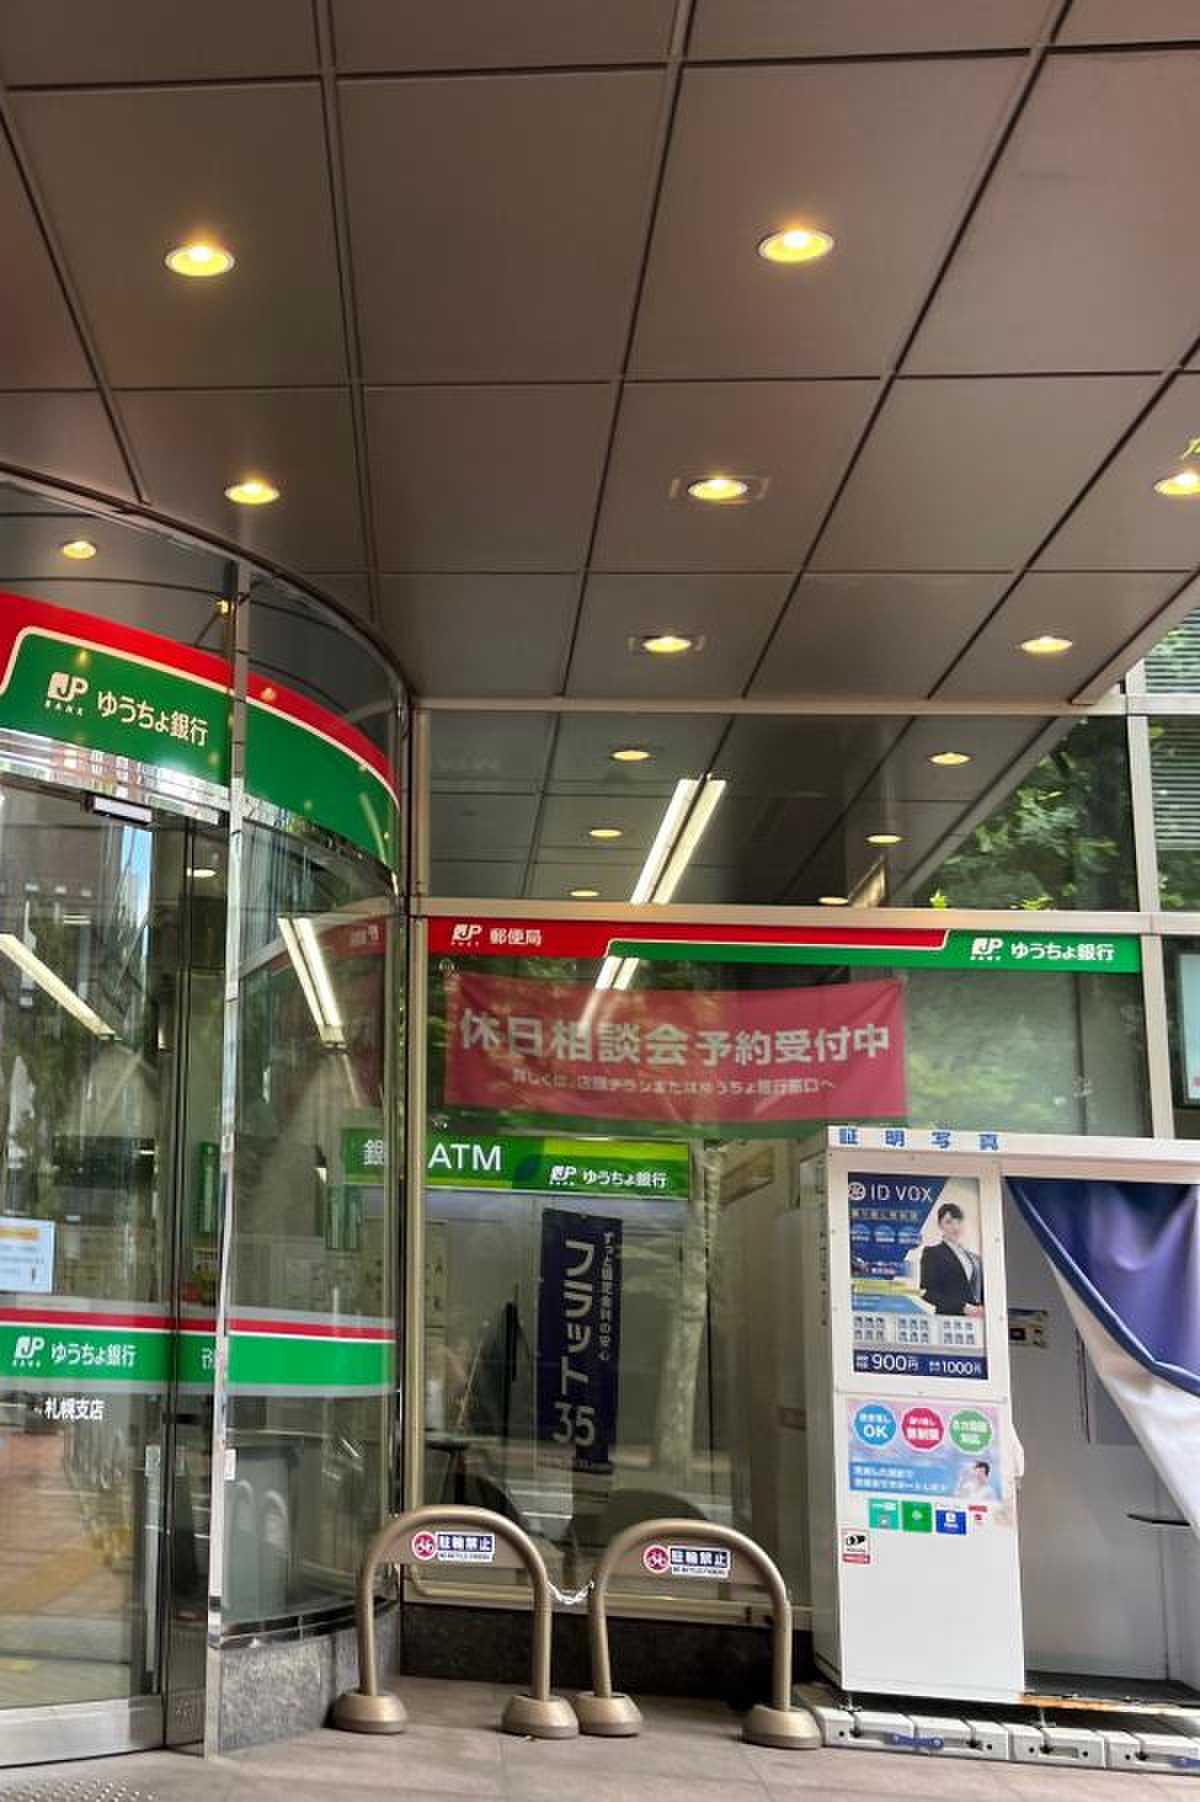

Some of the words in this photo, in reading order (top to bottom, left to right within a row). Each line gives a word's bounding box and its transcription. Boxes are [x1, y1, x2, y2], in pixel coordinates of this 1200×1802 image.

[96, 691, 209, 747] ゆうちょ銀行
[489, 927, 543, 947] 郵便局
[1011, 942, 1115, 961] ゆうちょ銀行
[459, 1007, 890, 1067] 休日相談会予約受付中
[427, 1143, 502, 1171] ATM
[583, 1169, 667, 1188] ゆうちょ銀行
[870, 1184, 890, 1200] ID
[895, 1185, 934, 1202] VOX
[51, 1344, 137, 1369] ゆうちょ銀行
[44, 1397, 105, 1420] 札幌支店
[863, 1424, 889, 1439] OK
